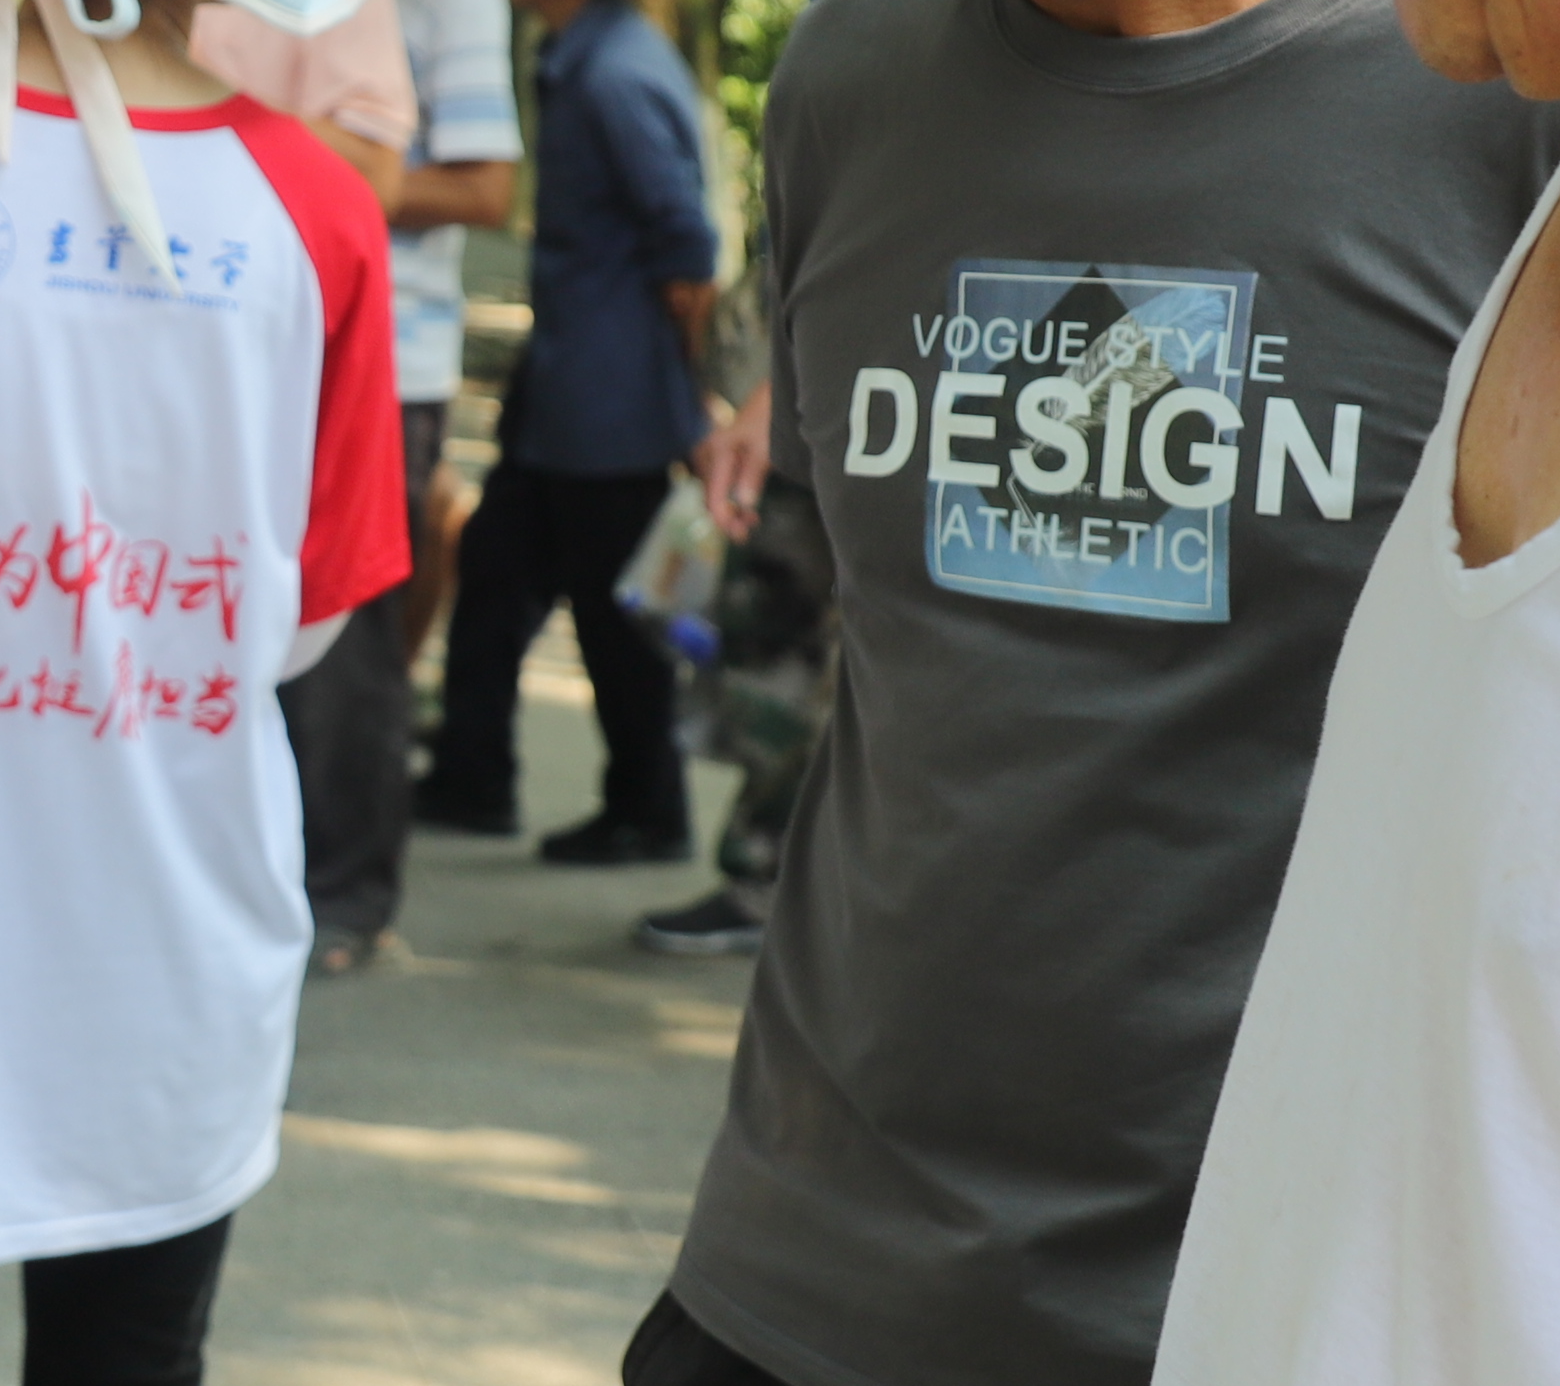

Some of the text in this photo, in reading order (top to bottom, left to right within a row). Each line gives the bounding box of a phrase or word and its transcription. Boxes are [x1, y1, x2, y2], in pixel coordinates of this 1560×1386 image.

[913, 314, 1290, 384] VOGUE STYLE
[843, 367, 1362, 522] DESIGN
[939, 502, 1208, 575] ATHLETIC
